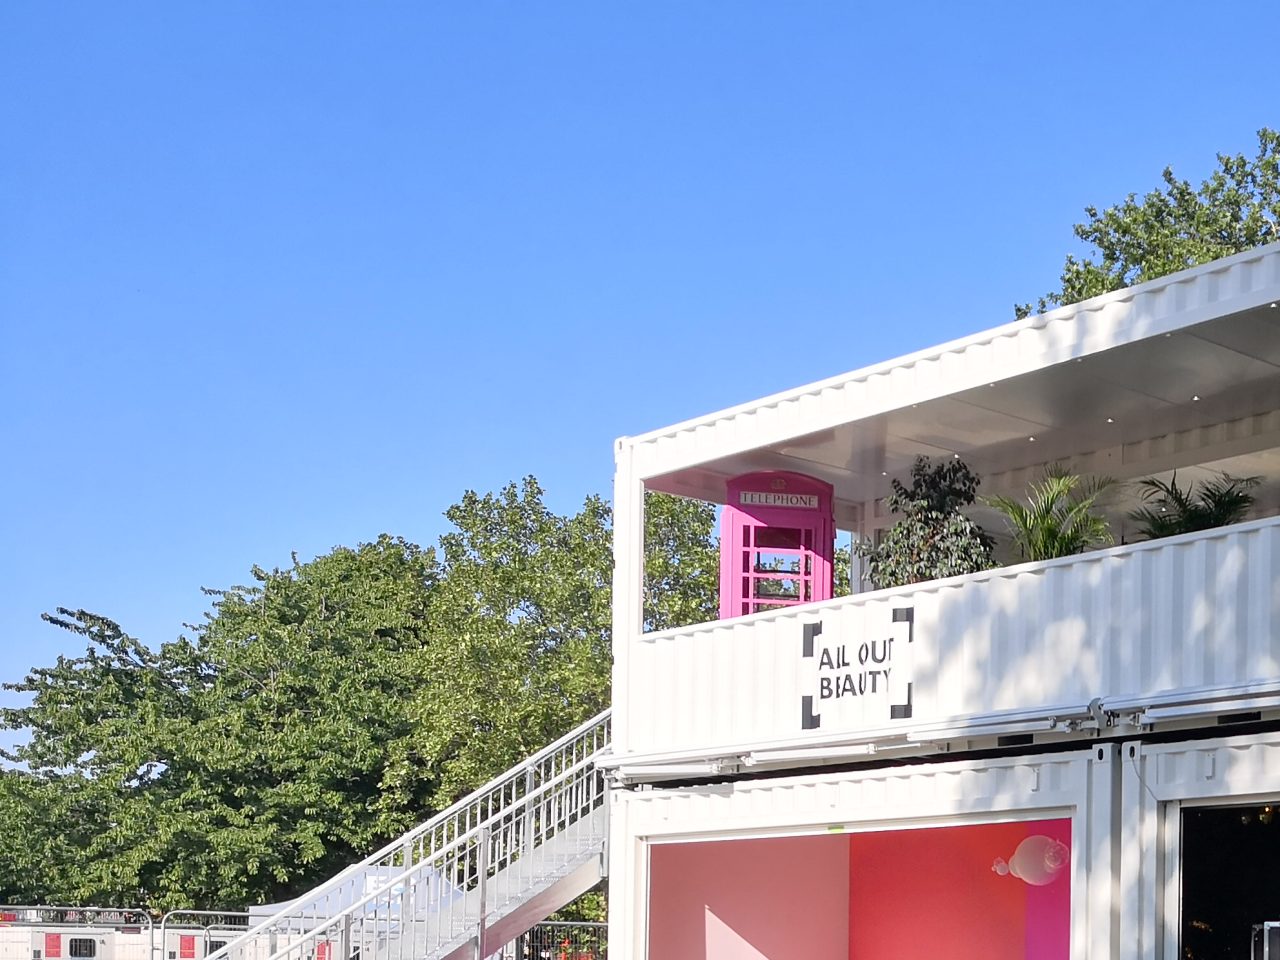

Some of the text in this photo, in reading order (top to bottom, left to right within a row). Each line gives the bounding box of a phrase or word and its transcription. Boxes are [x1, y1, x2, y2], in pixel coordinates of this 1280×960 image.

[743, 492, 815, 506] TELEPHONE
[819, 637, 894, 671] ALL OUT
[820, 667, 891, 700] BEAUTY
